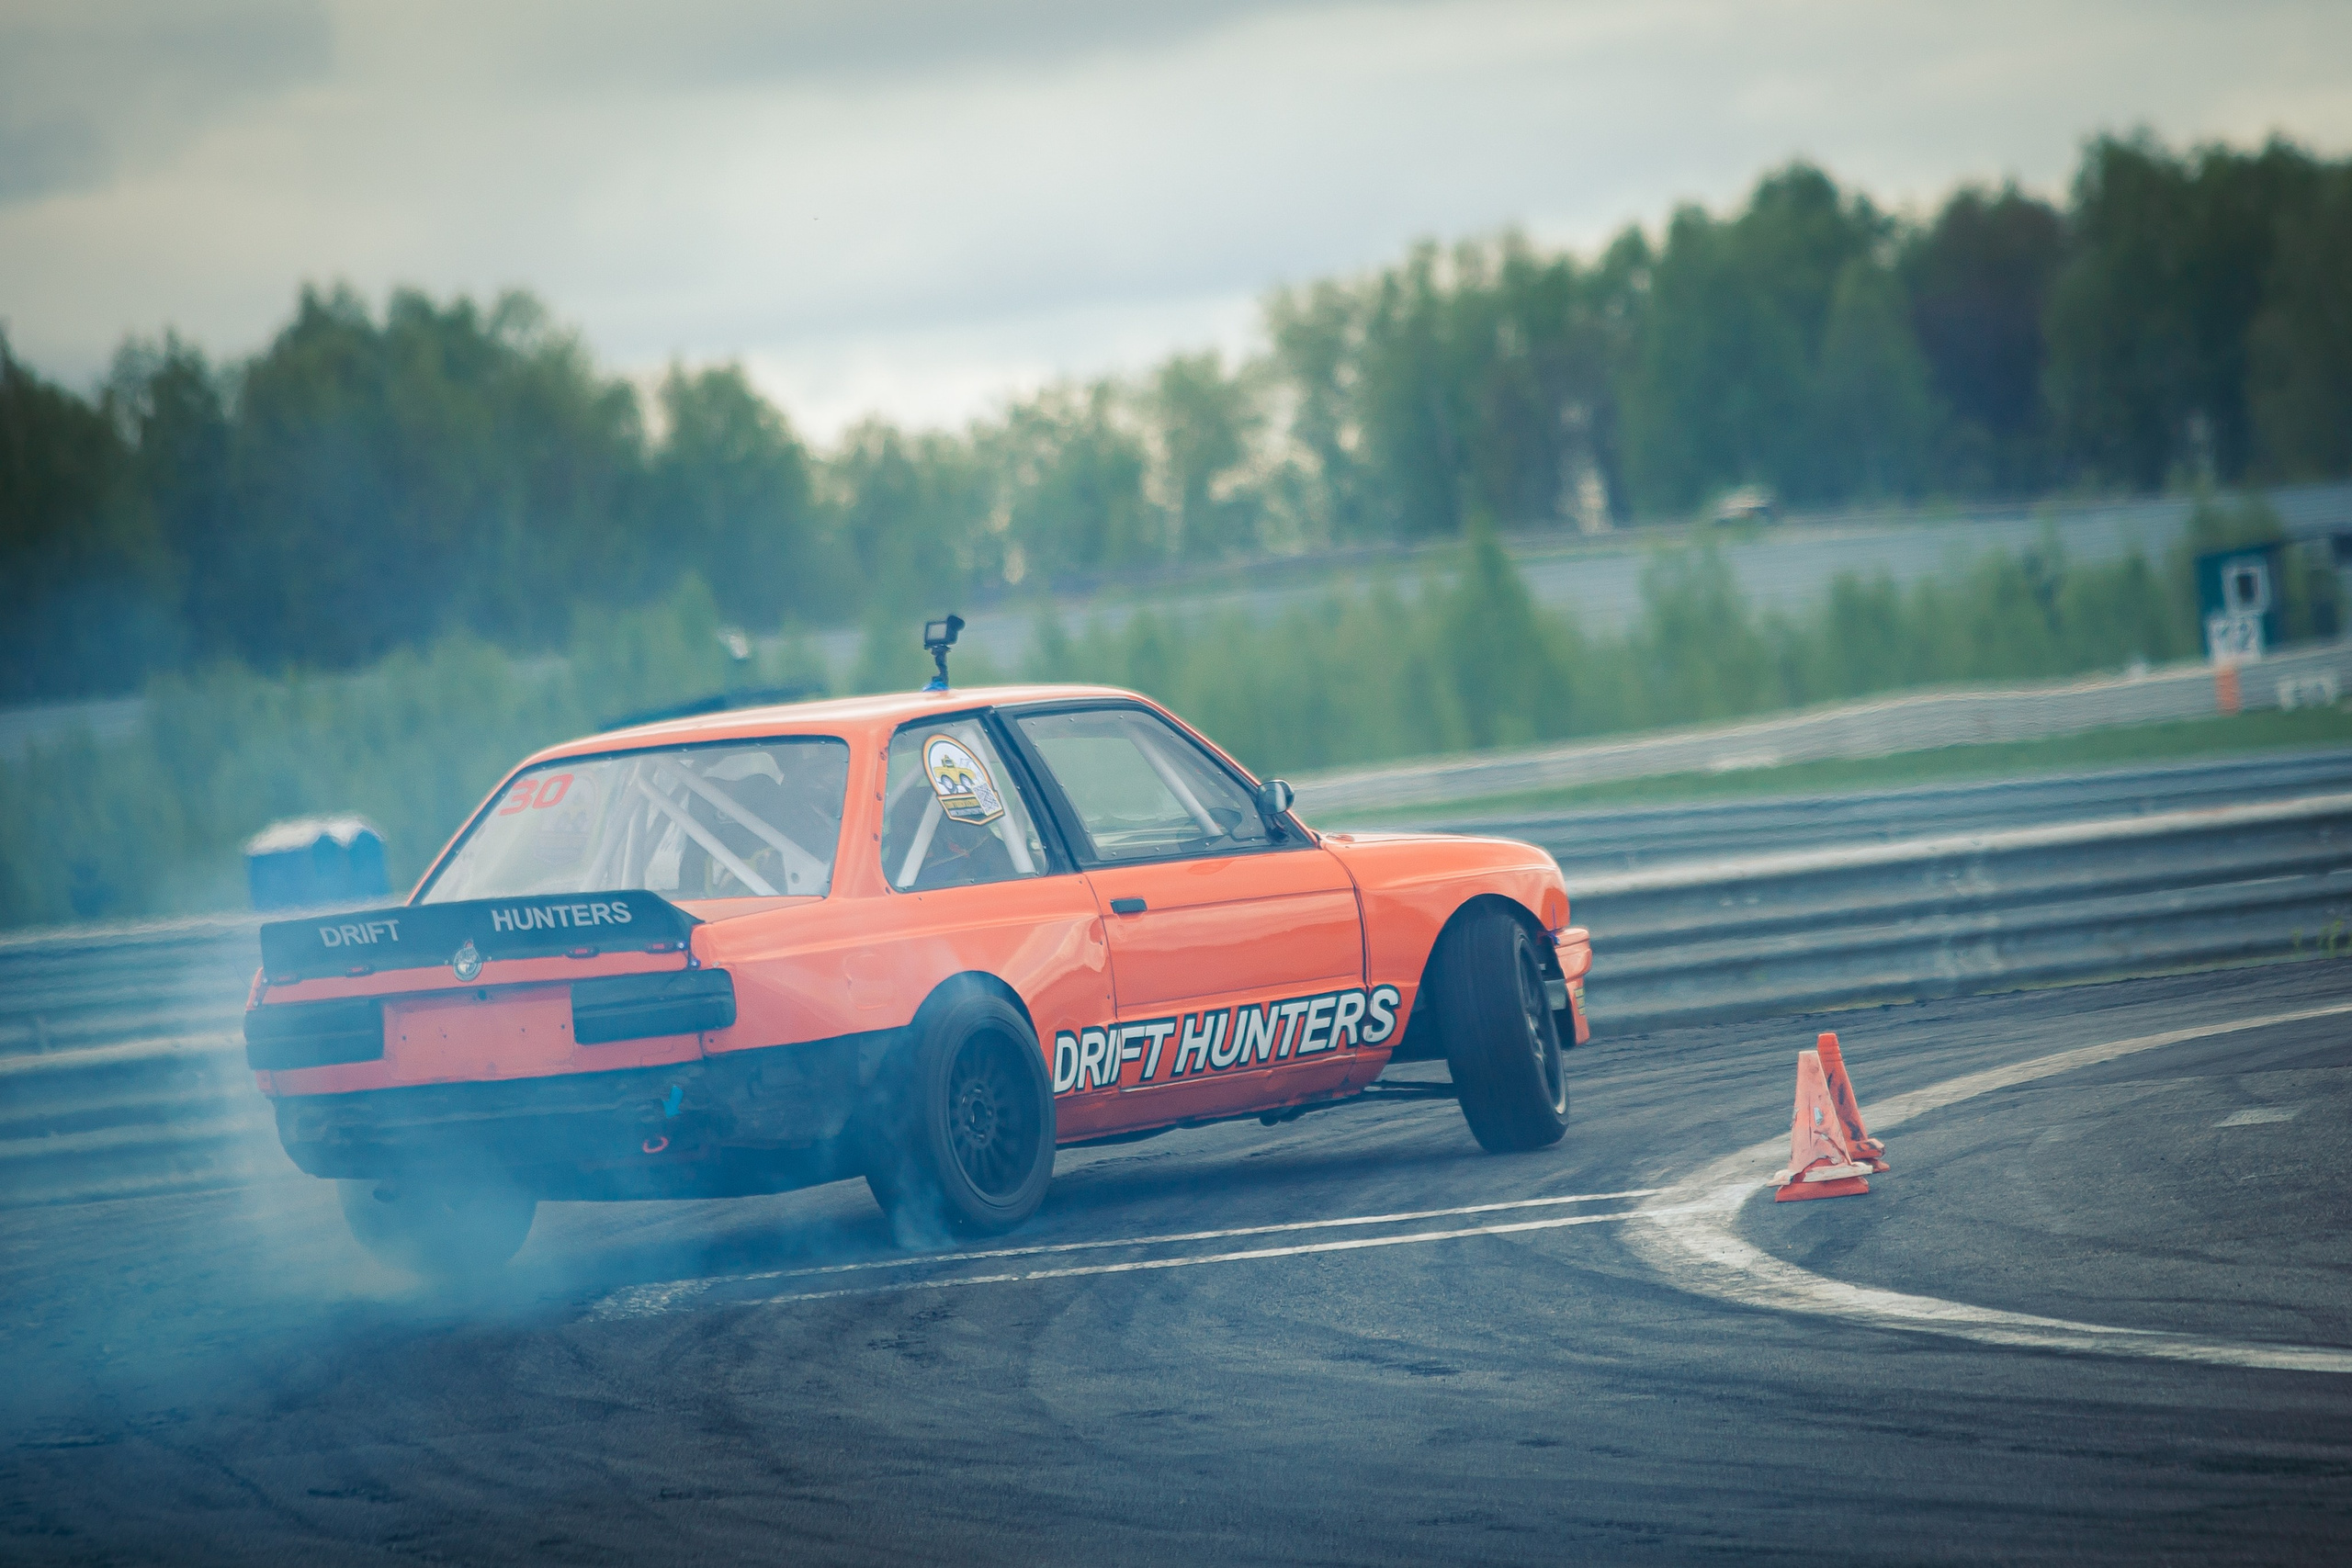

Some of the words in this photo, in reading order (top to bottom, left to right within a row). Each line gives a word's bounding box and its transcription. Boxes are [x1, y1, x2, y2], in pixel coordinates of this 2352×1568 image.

[499, 773, 574, 816] 30
[319, 919, 400, 948] DRIFT
[491, 901, 632, 932] HUNTERS
[1054, 1021, 1175, 1094] DRIFT
[1173, 986, 1401, 1076] HUNTERS
